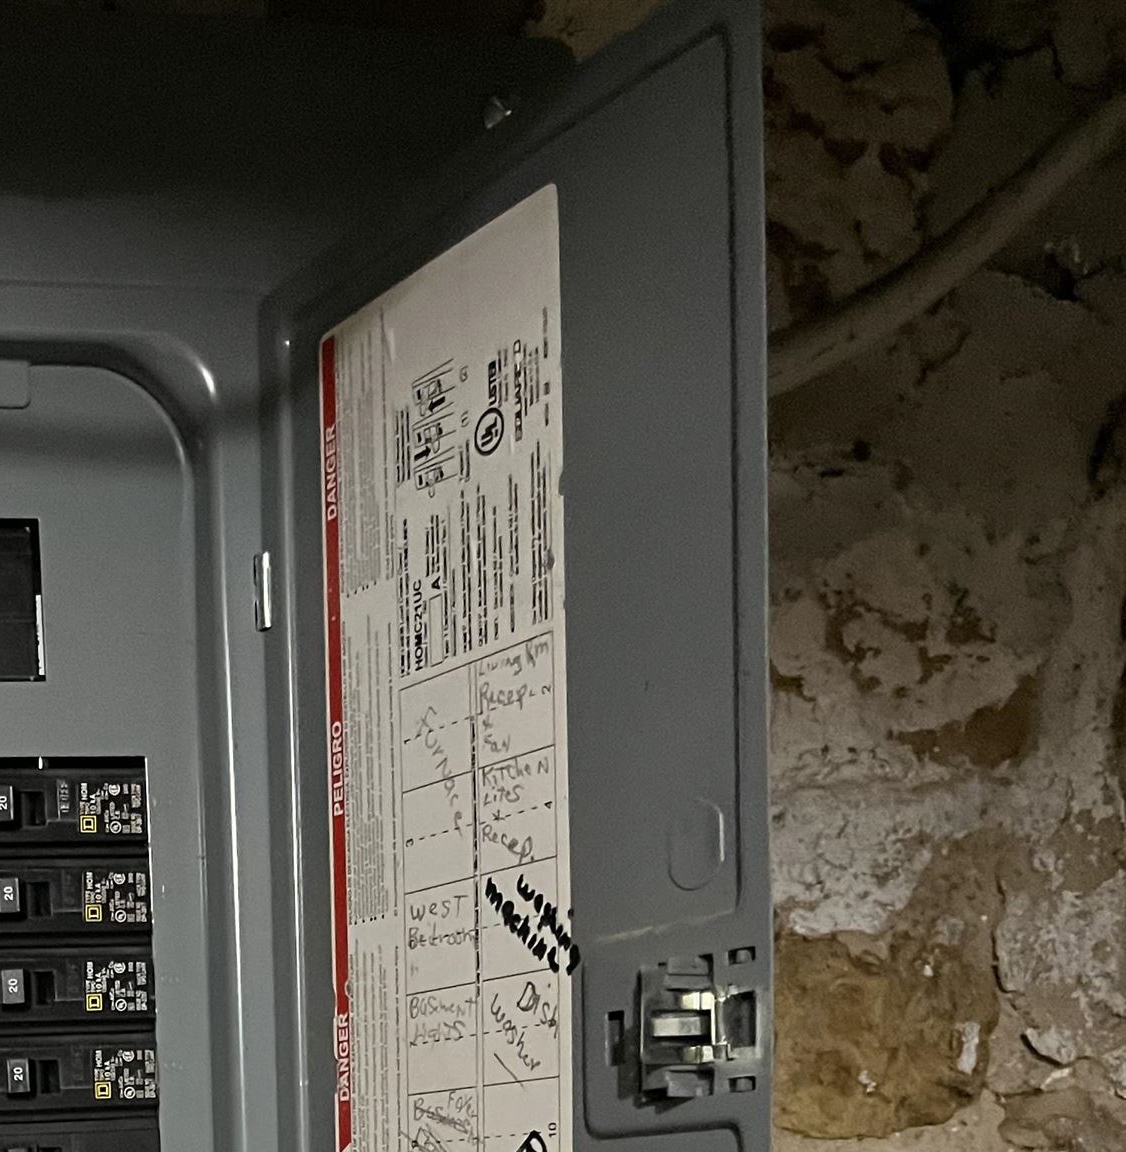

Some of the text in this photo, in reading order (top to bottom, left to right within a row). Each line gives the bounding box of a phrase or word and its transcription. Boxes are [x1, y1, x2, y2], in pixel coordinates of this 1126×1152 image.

[326, 422, 338, 521] DANGER
[431, 575, 441, 590] A
[413, 578, 425, 671] HOMC21UC
[542, 686, 552, 695] 2
[332, 720, 344, 817] PELIGRO
[91, 805, 96, 814] 10
[406, 839, 415, 847] 3
[4, 886, 13, 902] 20
[96, 894, 102, 903] 10
[9, 978, 18, 993] 20
[96, 983, 102, 992] 10
[338, 1013, 349, 1102] DANGER
[14, 1067, 24, 1082] 20
[105, 1071, 111, 1081] 10
[548, 1122, 557, 1137] 10
